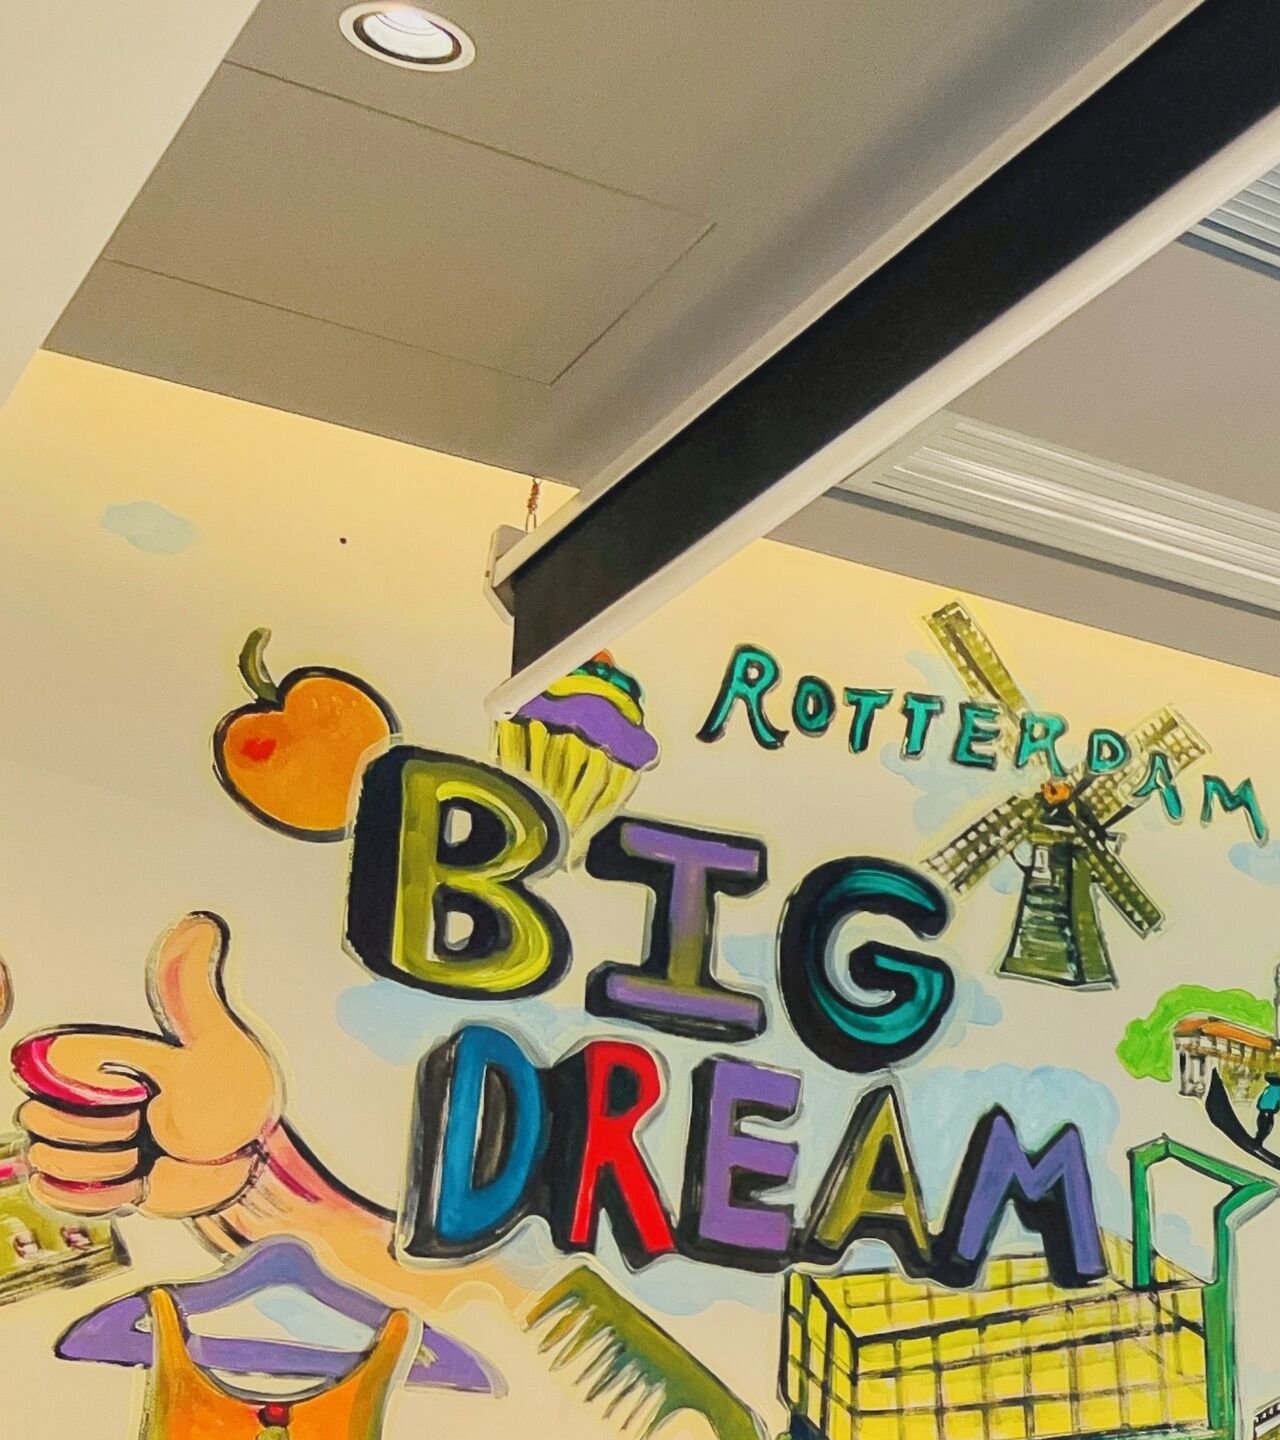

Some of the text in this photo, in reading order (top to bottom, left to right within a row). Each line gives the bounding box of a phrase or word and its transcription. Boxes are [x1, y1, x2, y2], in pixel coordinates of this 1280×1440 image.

[696, 644, 1268, 843] ROTTERDAM
[347, 744, 955, 1074] BIG
[402, 1020, 1106, 1289] DREAM
